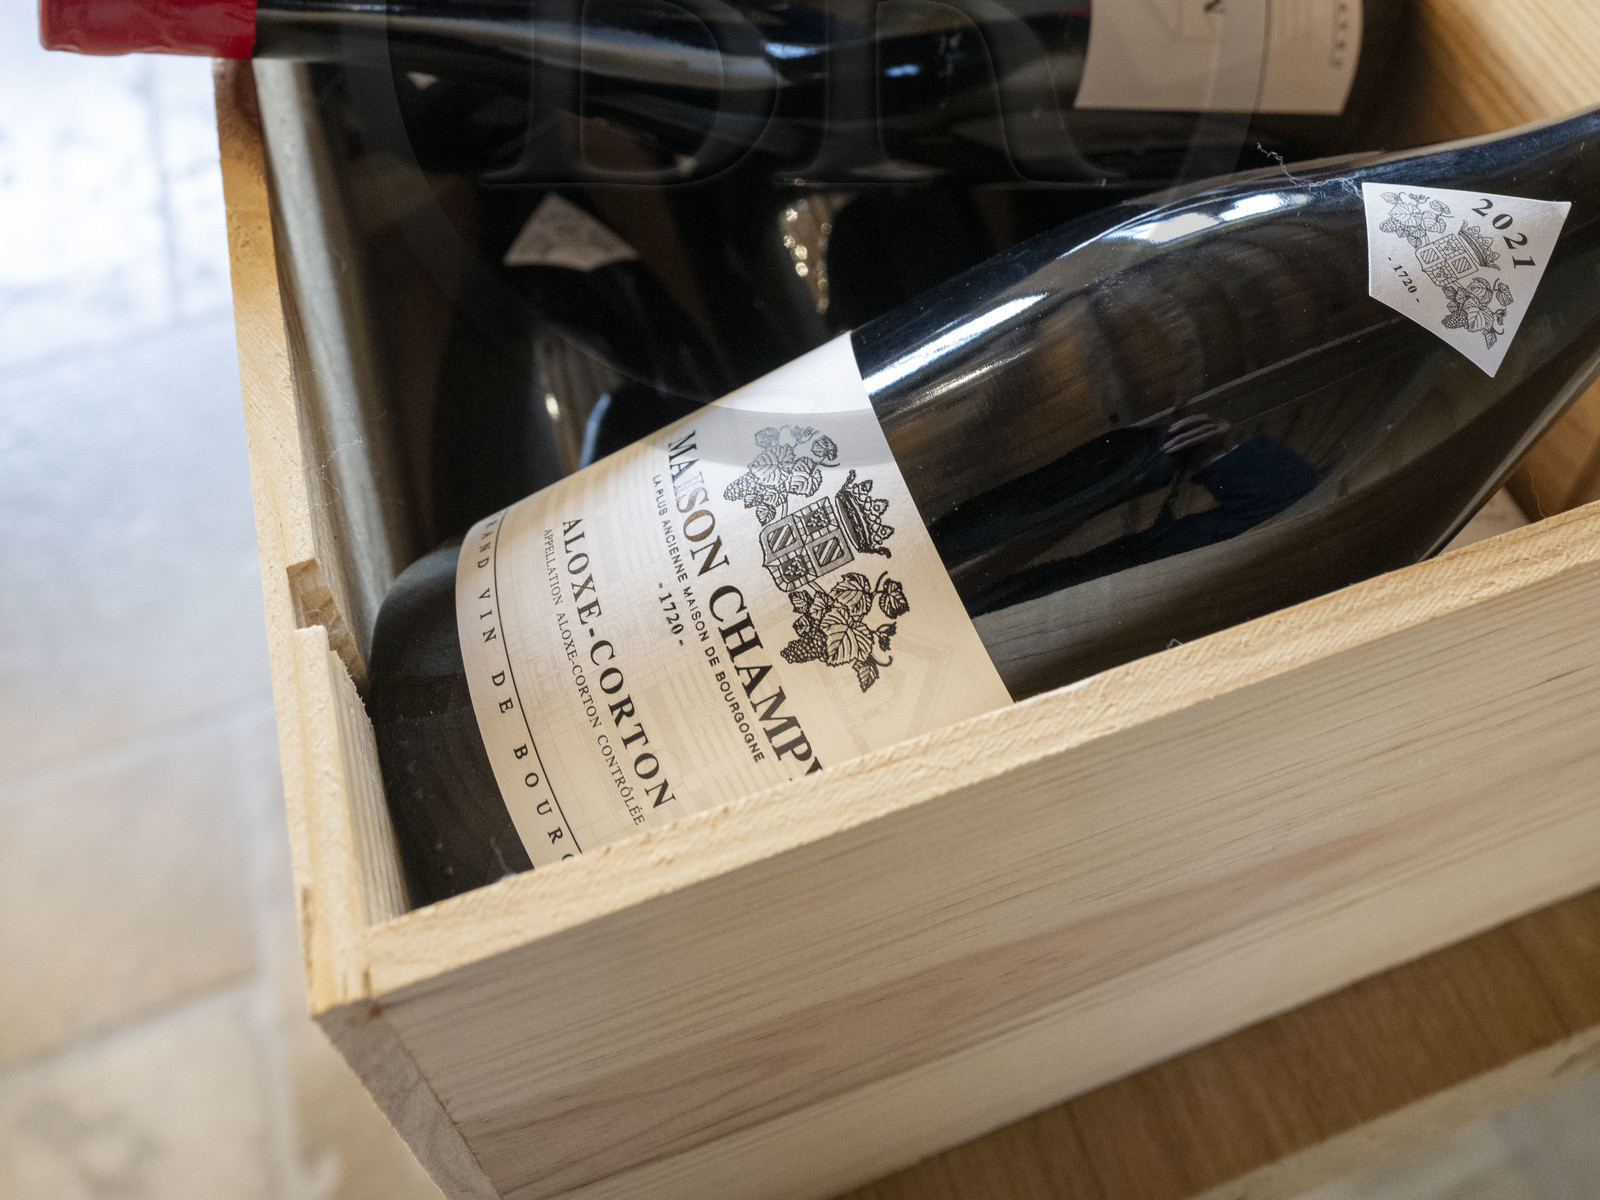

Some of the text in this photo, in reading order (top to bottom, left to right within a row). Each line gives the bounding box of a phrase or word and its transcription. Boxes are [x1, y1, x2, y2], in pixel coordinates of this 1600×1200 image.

[1471, 198, 1537, 269] 2021
[652, 473, 765, 763] LA PLUS ANCIENNE MAISON DE BOURGOGNE
[667, 429, 731, 578] MAISON
[477, 512, 575, 861] RAND VIN DE BOUR
[544, 528, 646, 826] APPELLATION ALOXE-CORTON CONTRÔLÉE
[562, 517, 677, 809] ALOXE-CORTON
